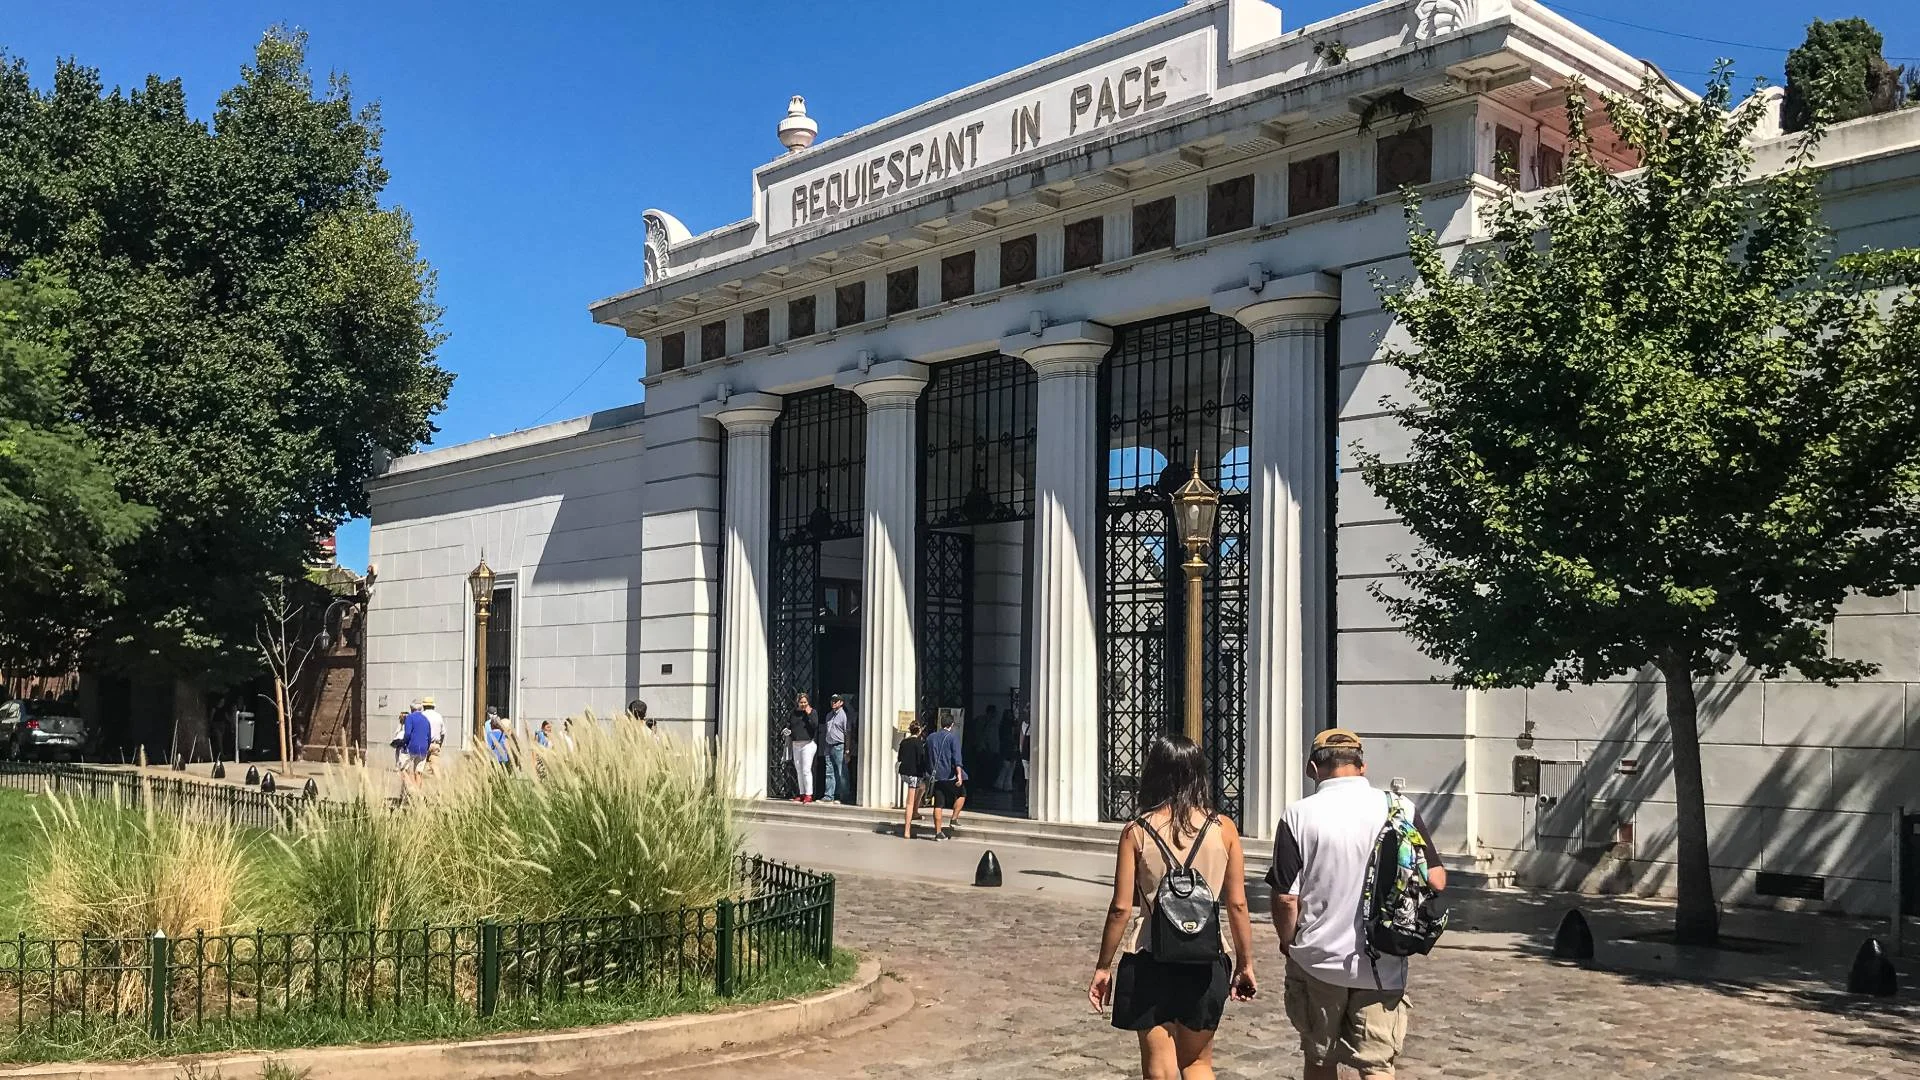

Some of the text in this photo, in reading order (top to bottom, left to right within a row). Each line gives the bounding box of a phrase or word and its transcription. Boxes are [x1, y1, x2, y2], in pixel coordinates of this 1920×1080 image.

[793, 56, 1167, 227] REQUIESCANT IN PACE
